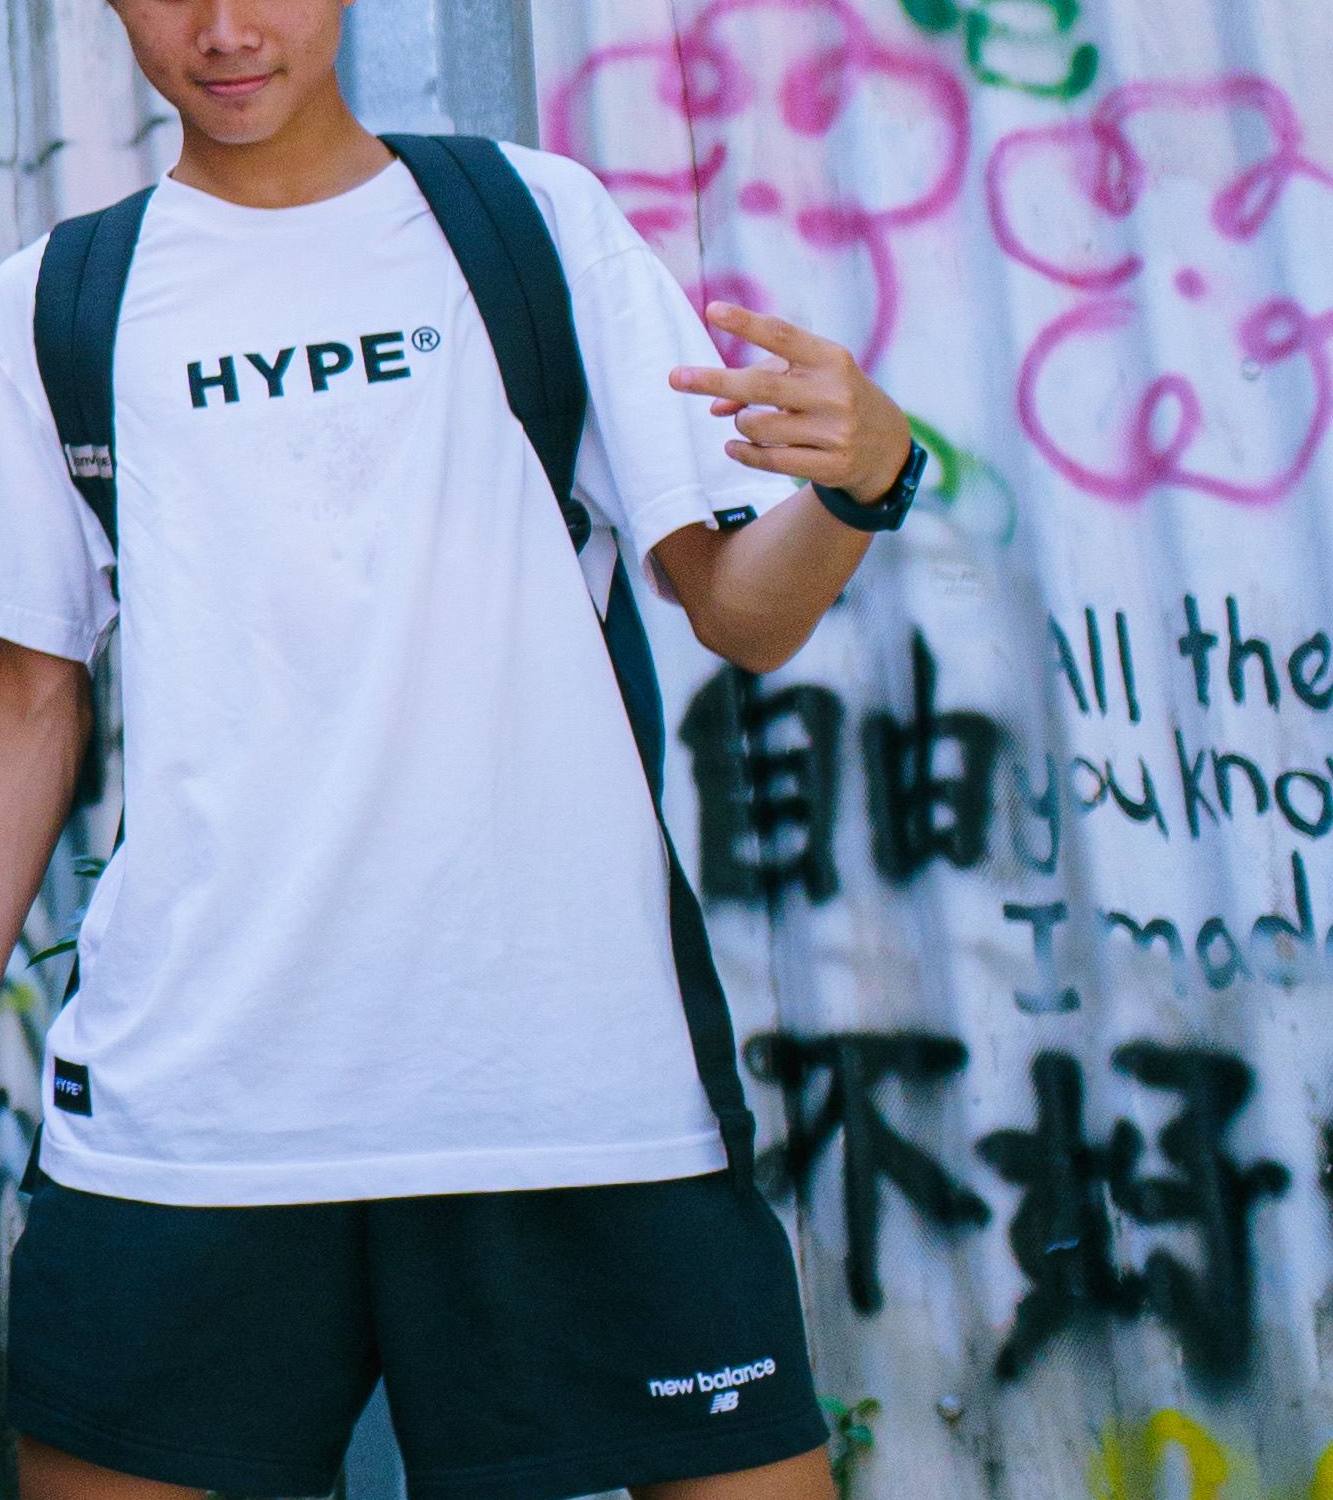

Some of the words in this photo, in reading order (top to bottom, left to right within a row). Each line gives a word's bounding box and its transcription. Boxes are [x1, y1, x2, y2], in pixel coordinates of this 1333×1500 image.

[1177, 594, 1333, 712] the
[1013, 750, 1170, 876] you
[1173, 726, 1333, 840] kno
[1097, 850, 1333, 997] mad
[649, 1377, 694, 1397] new
[696, 1357, 777, 1393] balance
